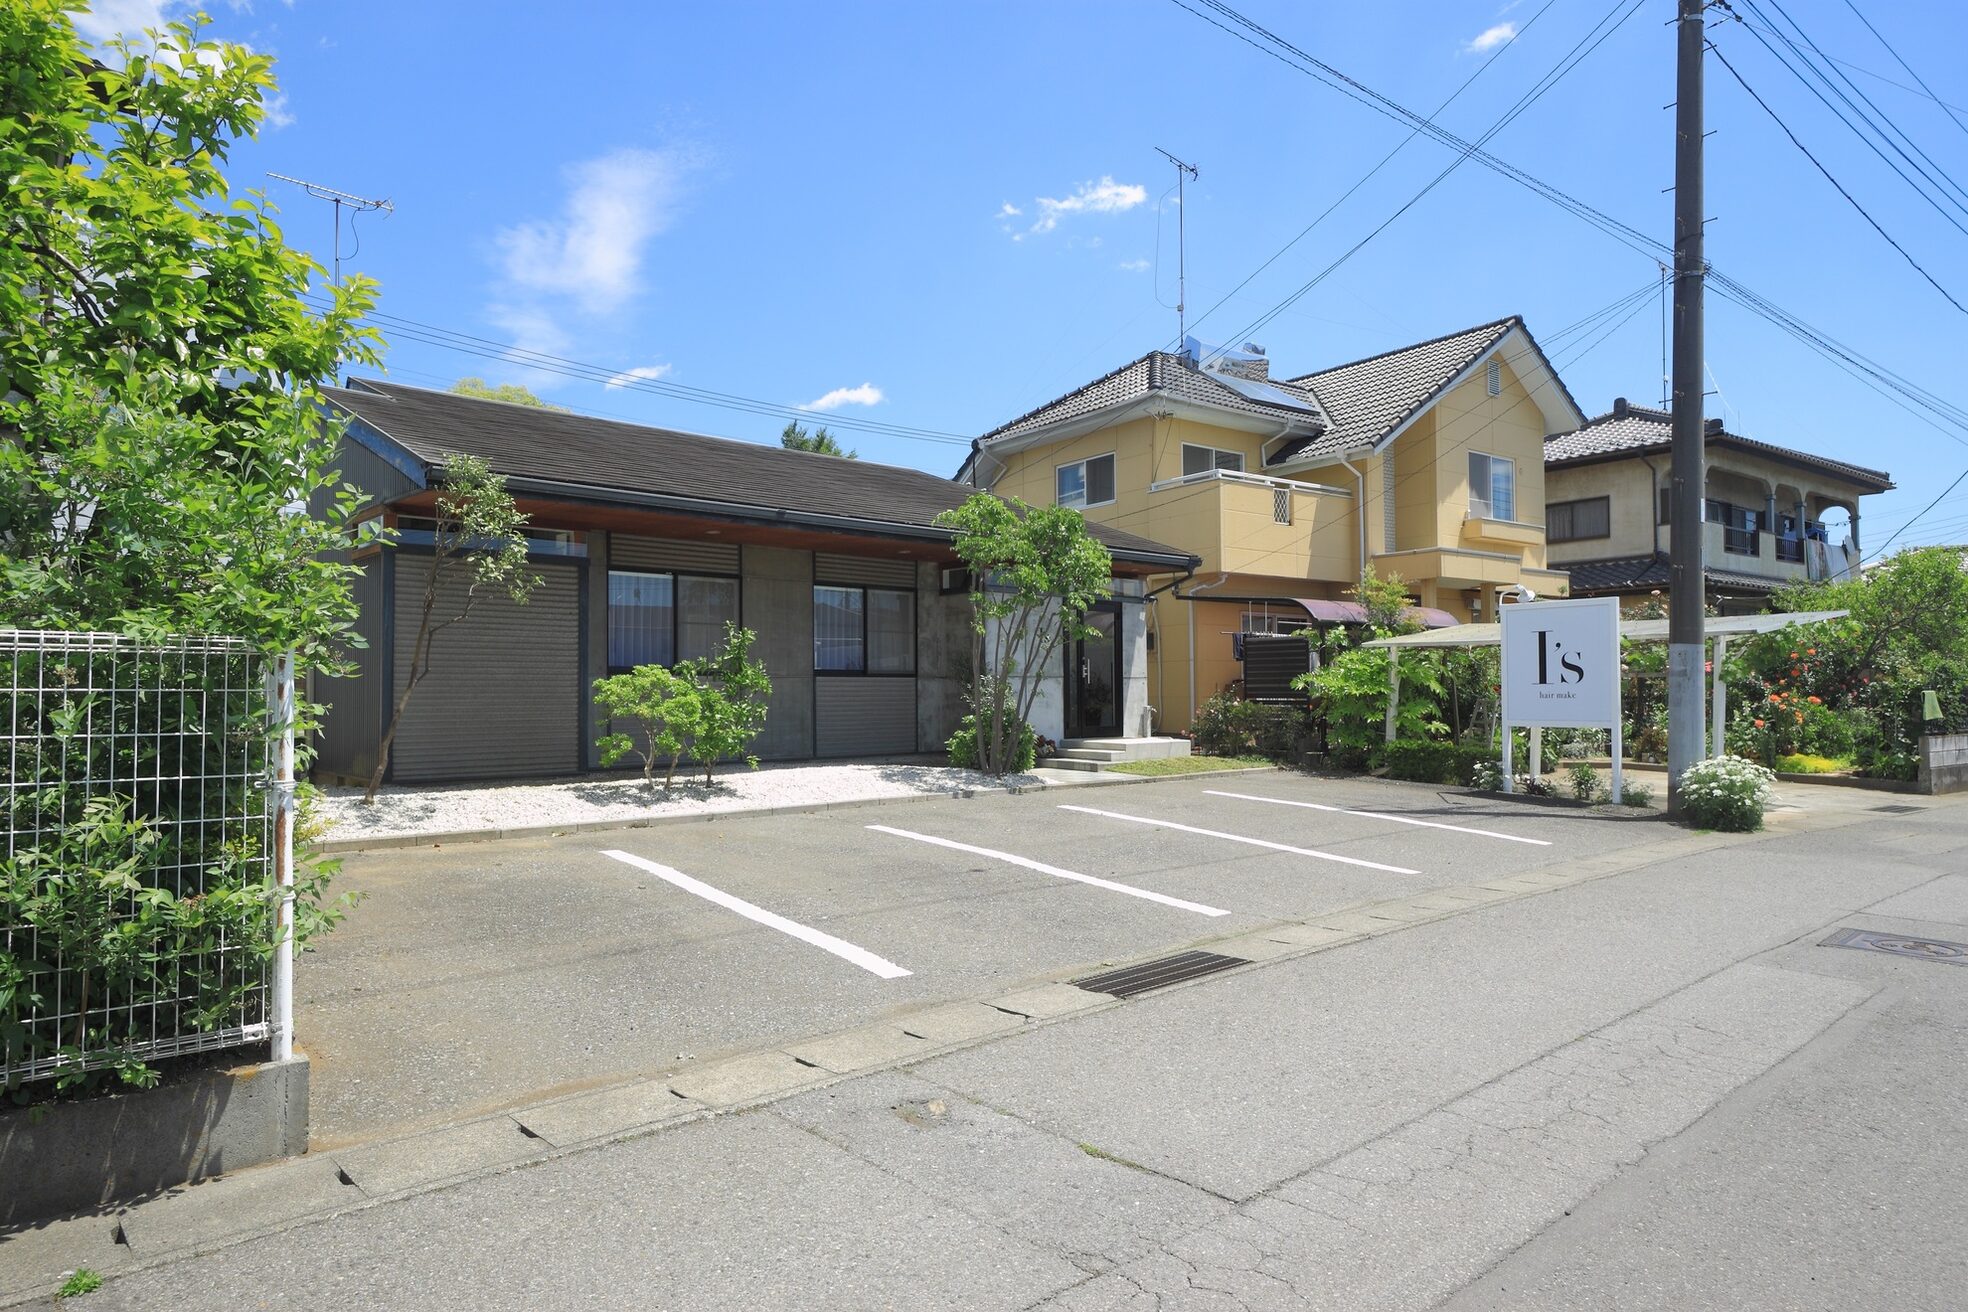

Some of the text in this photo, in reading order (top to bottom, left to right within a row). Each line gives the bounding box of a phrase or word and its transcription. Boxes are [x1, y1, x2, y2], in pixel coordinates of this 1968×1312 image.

[1531, 630, 1584, 685] I's
[1539, 690, 1577, 699] hair make
